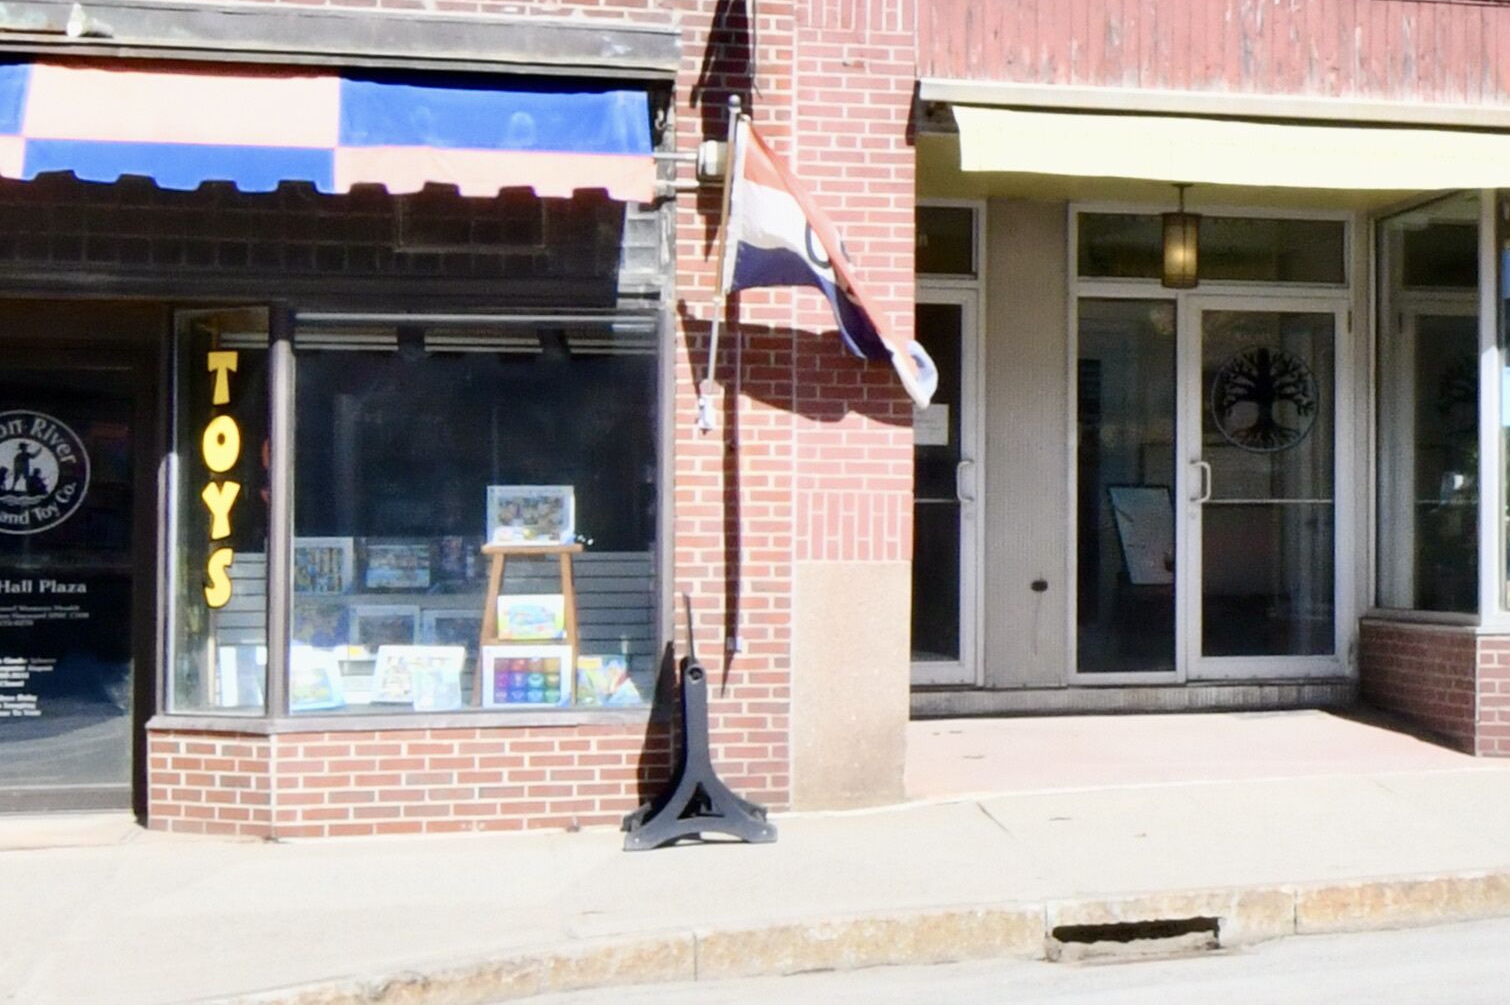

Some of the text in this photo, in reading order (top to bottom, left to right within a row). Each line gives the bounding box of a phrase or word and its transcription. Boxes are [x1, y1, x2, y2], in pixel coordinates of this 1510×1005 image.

[30, 418, 77, 463] River
[202, 351, 241, 608] TOYS
[31, 502, 60, 522] Toy
[39, 579, 88, 594] Plaza
